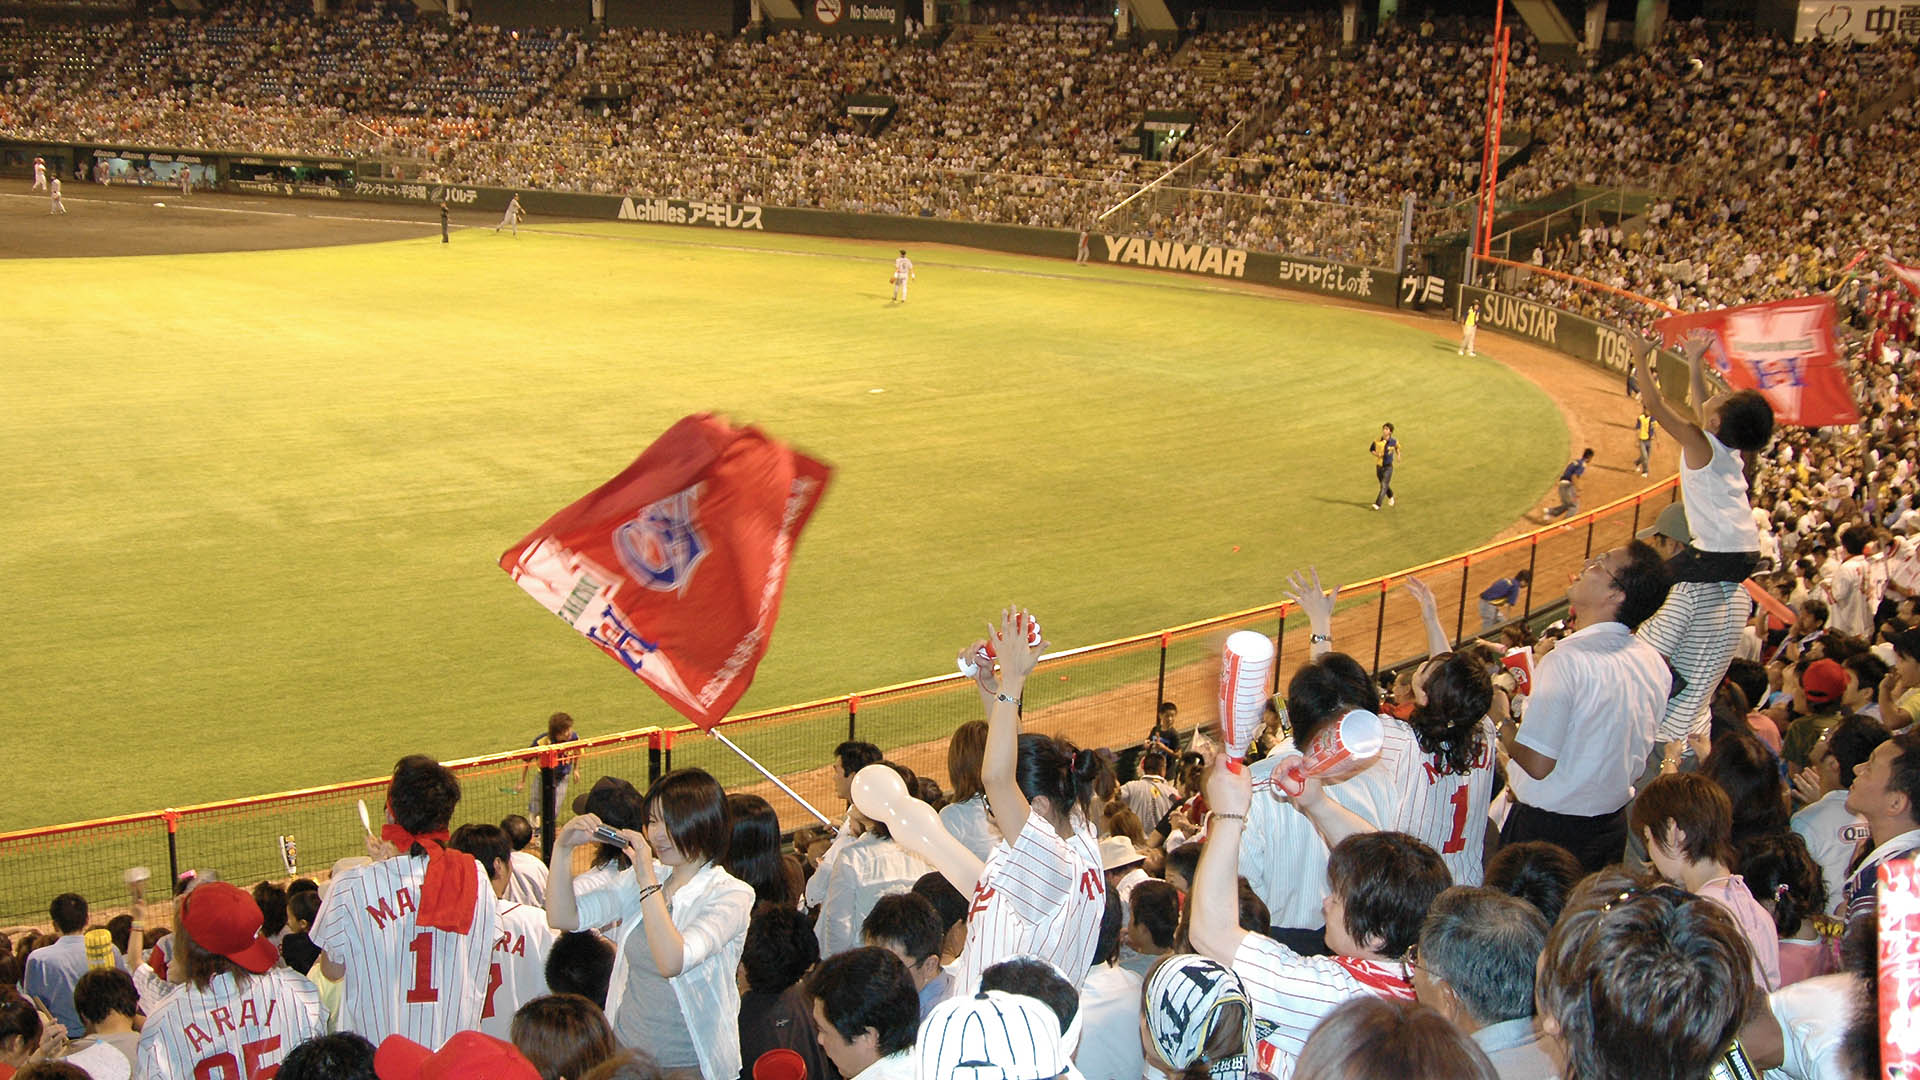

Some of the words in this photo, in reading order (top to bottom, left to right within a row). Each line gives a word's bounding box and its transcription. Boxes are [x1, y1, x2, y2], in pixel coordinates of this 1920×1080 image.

[850, 4, 861, 19] No
[863, 4, 896, 24] Smoking
[617, 196, 687, 224] Achilles
[688, 200, 764, 230] アキレス
[1104, 235, 1248, 278] YANMAR
[1279, 260, 1374, 297] シマヤだしの素
[1483, 294, 1558, 344] SUNSTAR
[1596, 327, 1658, 373] TOSA
[1441, 784, 1469, 854] 1
[406, 931, 438, 1003] 1
